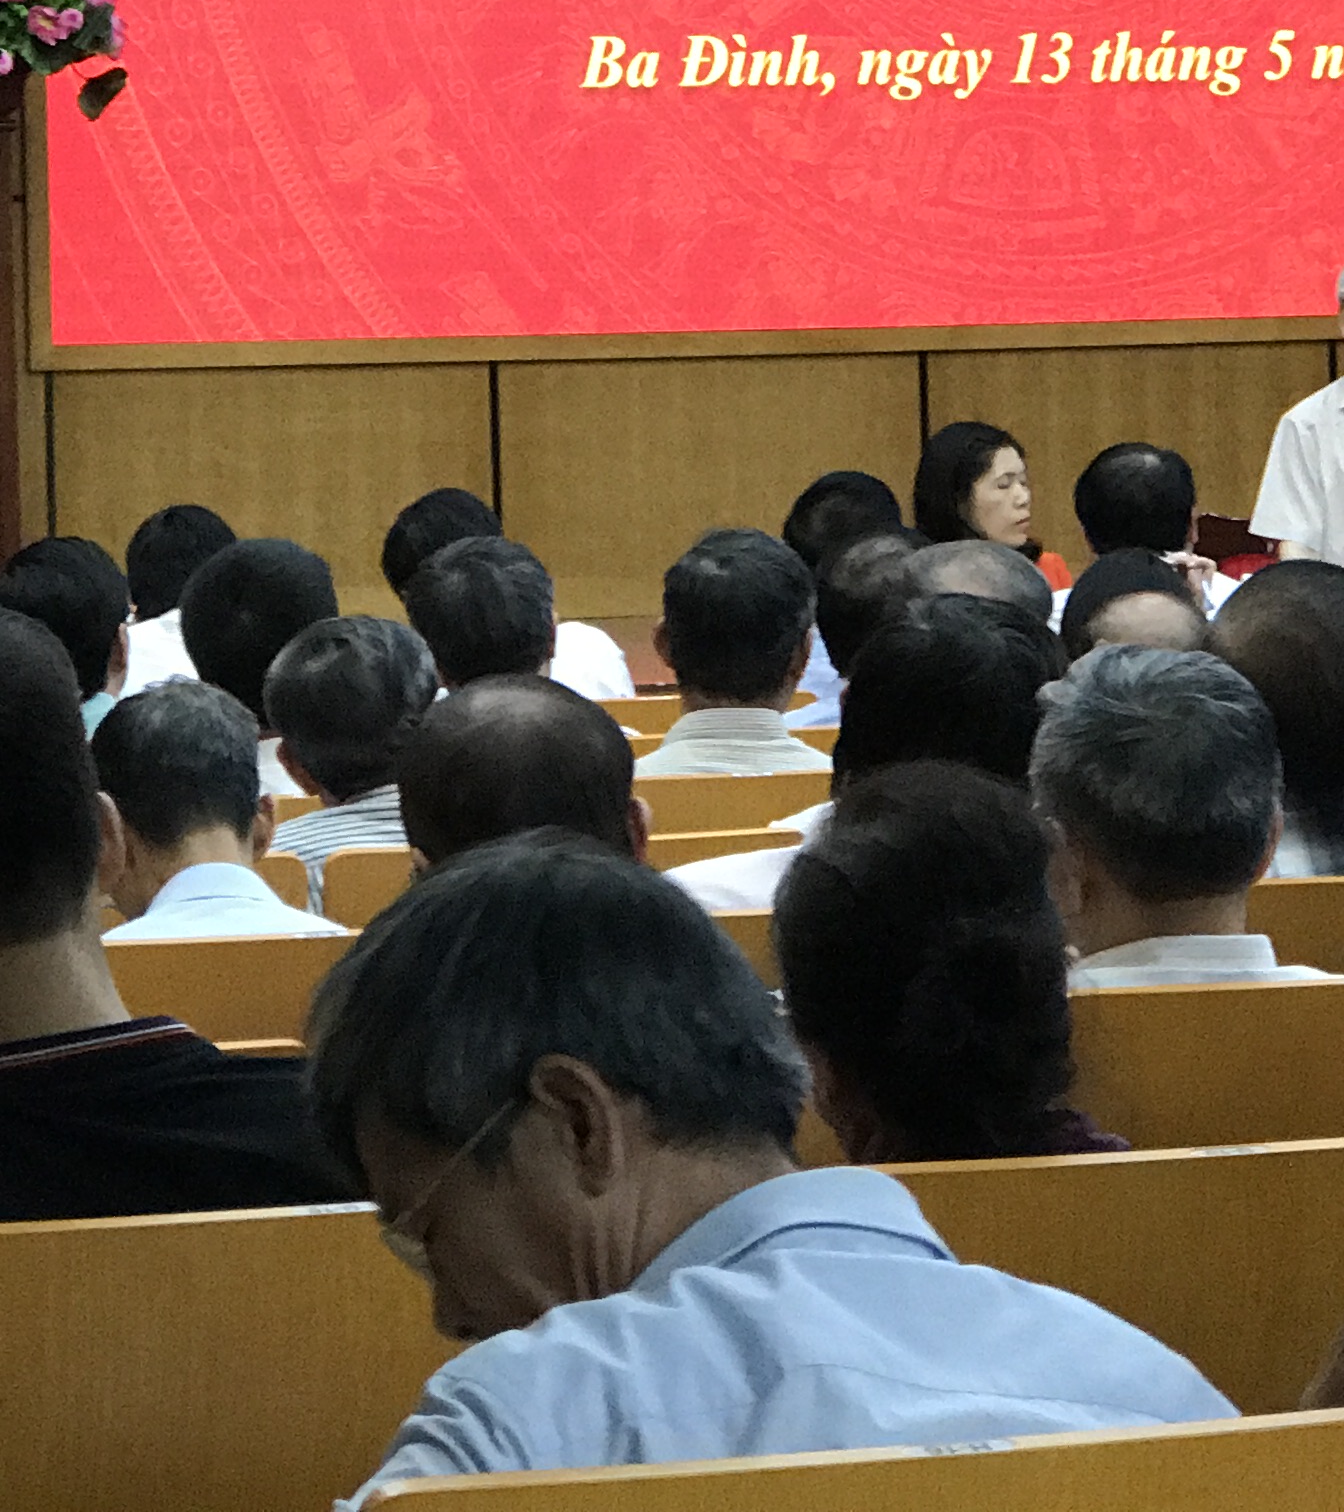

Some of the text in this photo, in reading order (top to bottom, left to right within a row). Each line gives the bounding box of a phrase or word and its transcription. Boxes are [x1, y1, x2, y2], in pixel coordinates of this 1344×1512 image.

[579, 36, 659, 88] Ba
[679, 34, 835, 95] Đình,
[858, 33, 992, 100] ngày
[1010, 32, 1073, 83] 13
[1091, 30, 1247, 95] tháng
[1264, 30, 1295, 80] 5
